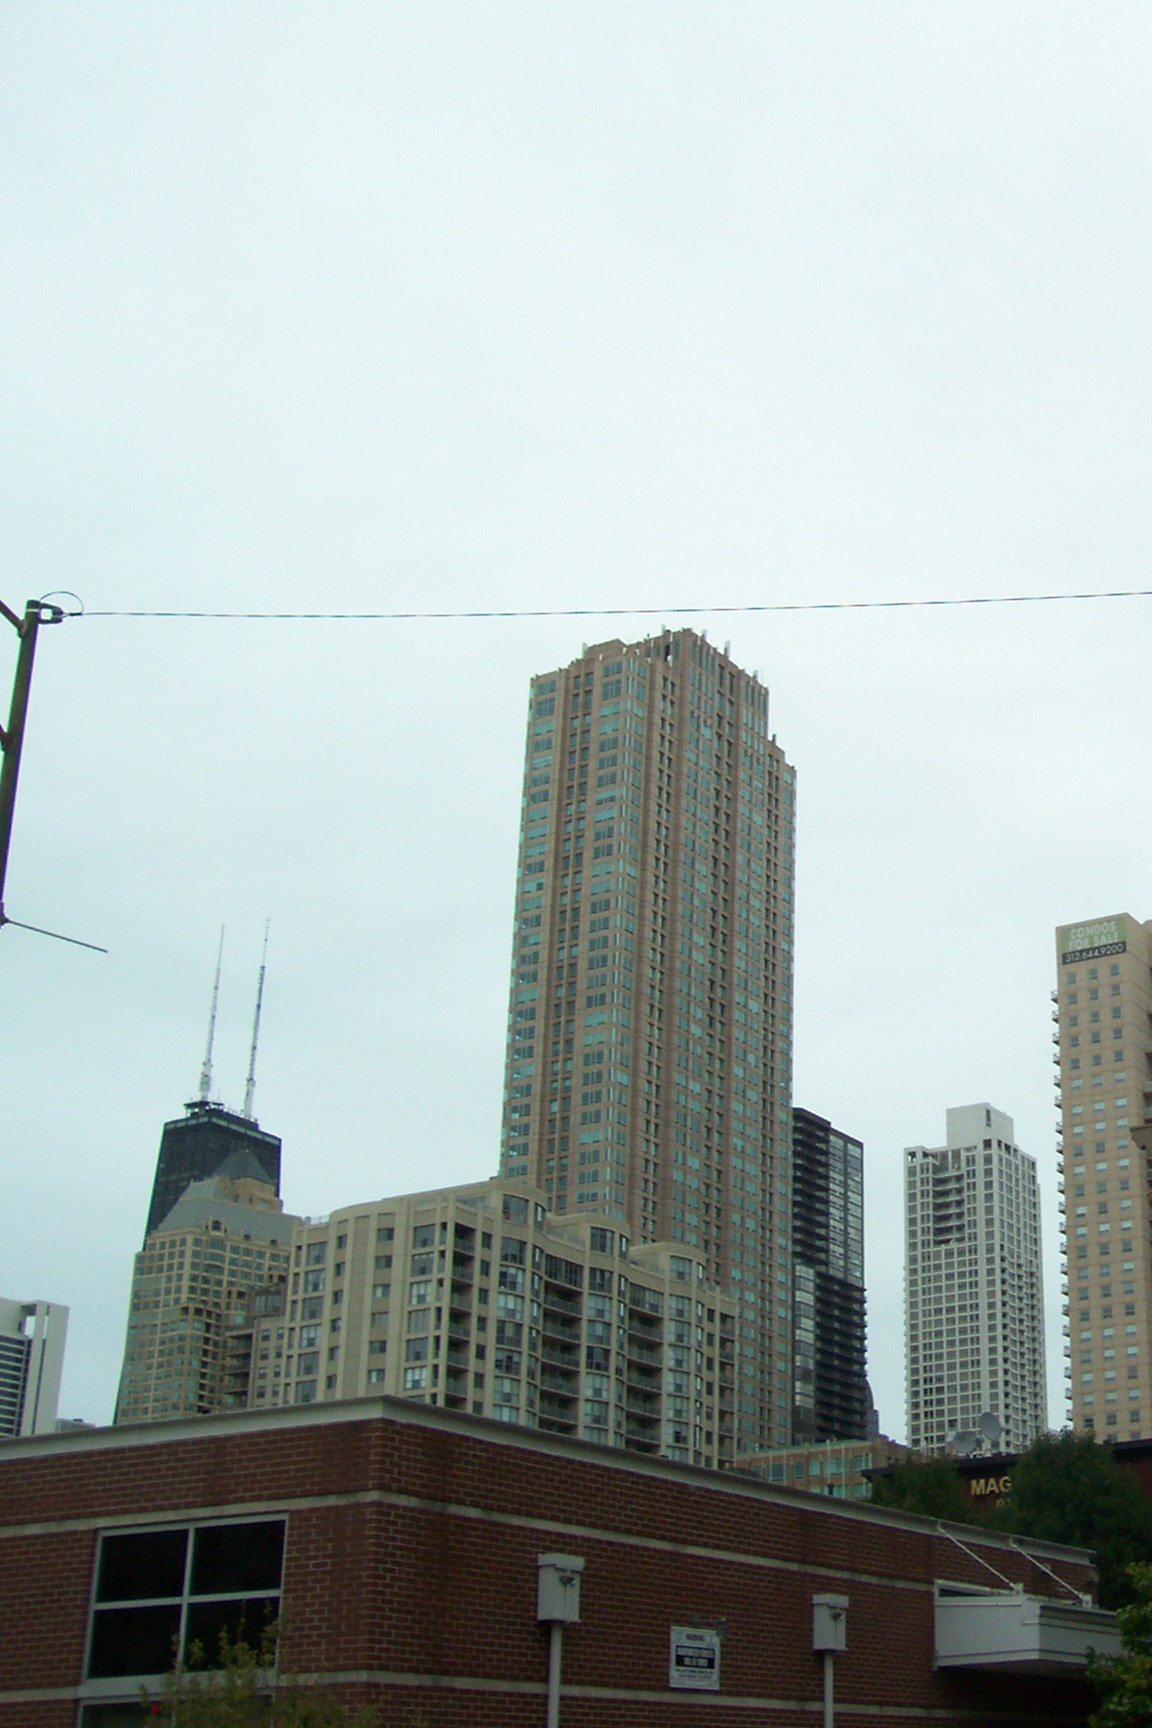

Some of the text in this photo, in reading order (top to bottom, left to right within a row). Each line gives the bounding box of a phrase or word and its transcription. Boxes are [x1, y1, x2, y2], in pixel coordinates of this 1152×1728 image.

[1070, 921, 1116, 939] CONDOS
[1068, 931, 1119, 951] FOR SALE
